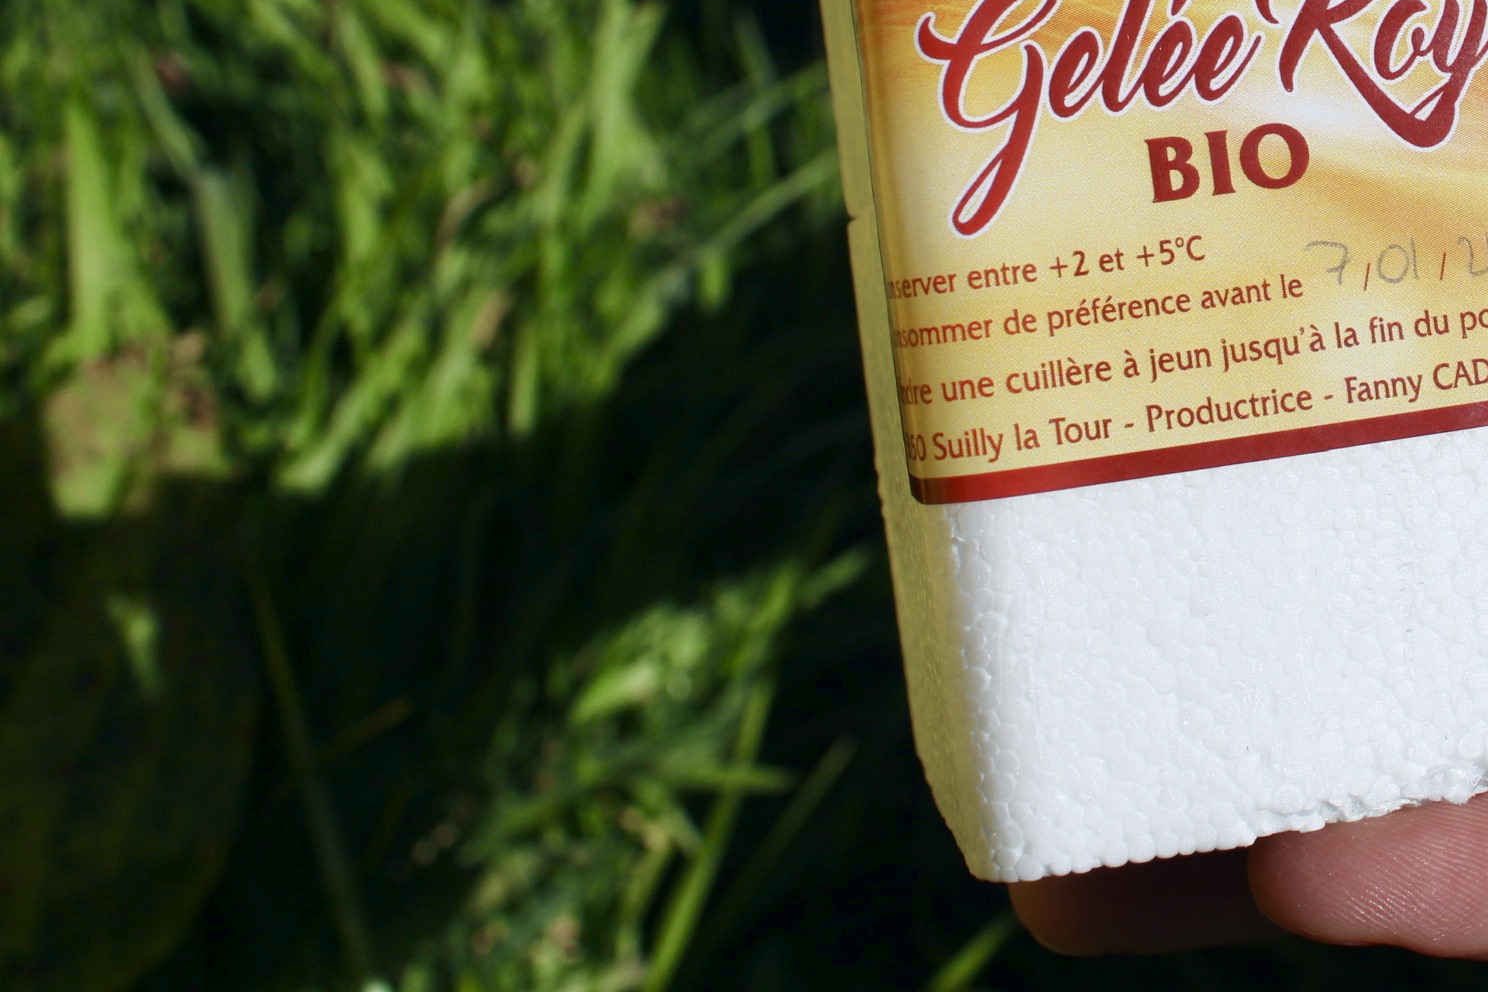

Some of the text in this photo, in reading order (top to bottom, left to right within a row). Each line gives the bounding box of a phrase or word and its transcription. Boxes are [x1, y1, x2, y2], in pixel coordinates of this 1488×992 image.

[1144, 122, 1310, 203] BIO
[968, 262, 1038, 290] entre
[1050, 250, 1090, 278] +2
[1098, 247, 1125, 273] et
[1136, 235, 1206, 268] +5°C
[1003, 309, 1038, 336] de
[1047, 292, 1191, 336] préférence
[1201, 278, 1271, 309] avant
[1280, 273, 1303, 299] le
[941, 376, 994, 403] une
[1005, 356, 1112, 393] cuillère
[1123, 349, 1141, 379] à
[1149, 346, 1212, 383] jeun
[1222, 323, 1326, 373] jusqu'à
[1334, 321, 1360, 349] la
[1369, 316, 1405, 345] fin
[1414, 309, 1450, 338] du
[932, 427, 1004, 463] Suilly
[1014, 422, 1041, 451] la
[1048, 417, 1113, 446] Tour
[1145, 388, 1313, 433] Productrice
[1344, 373, 1423, 404] Fanny
